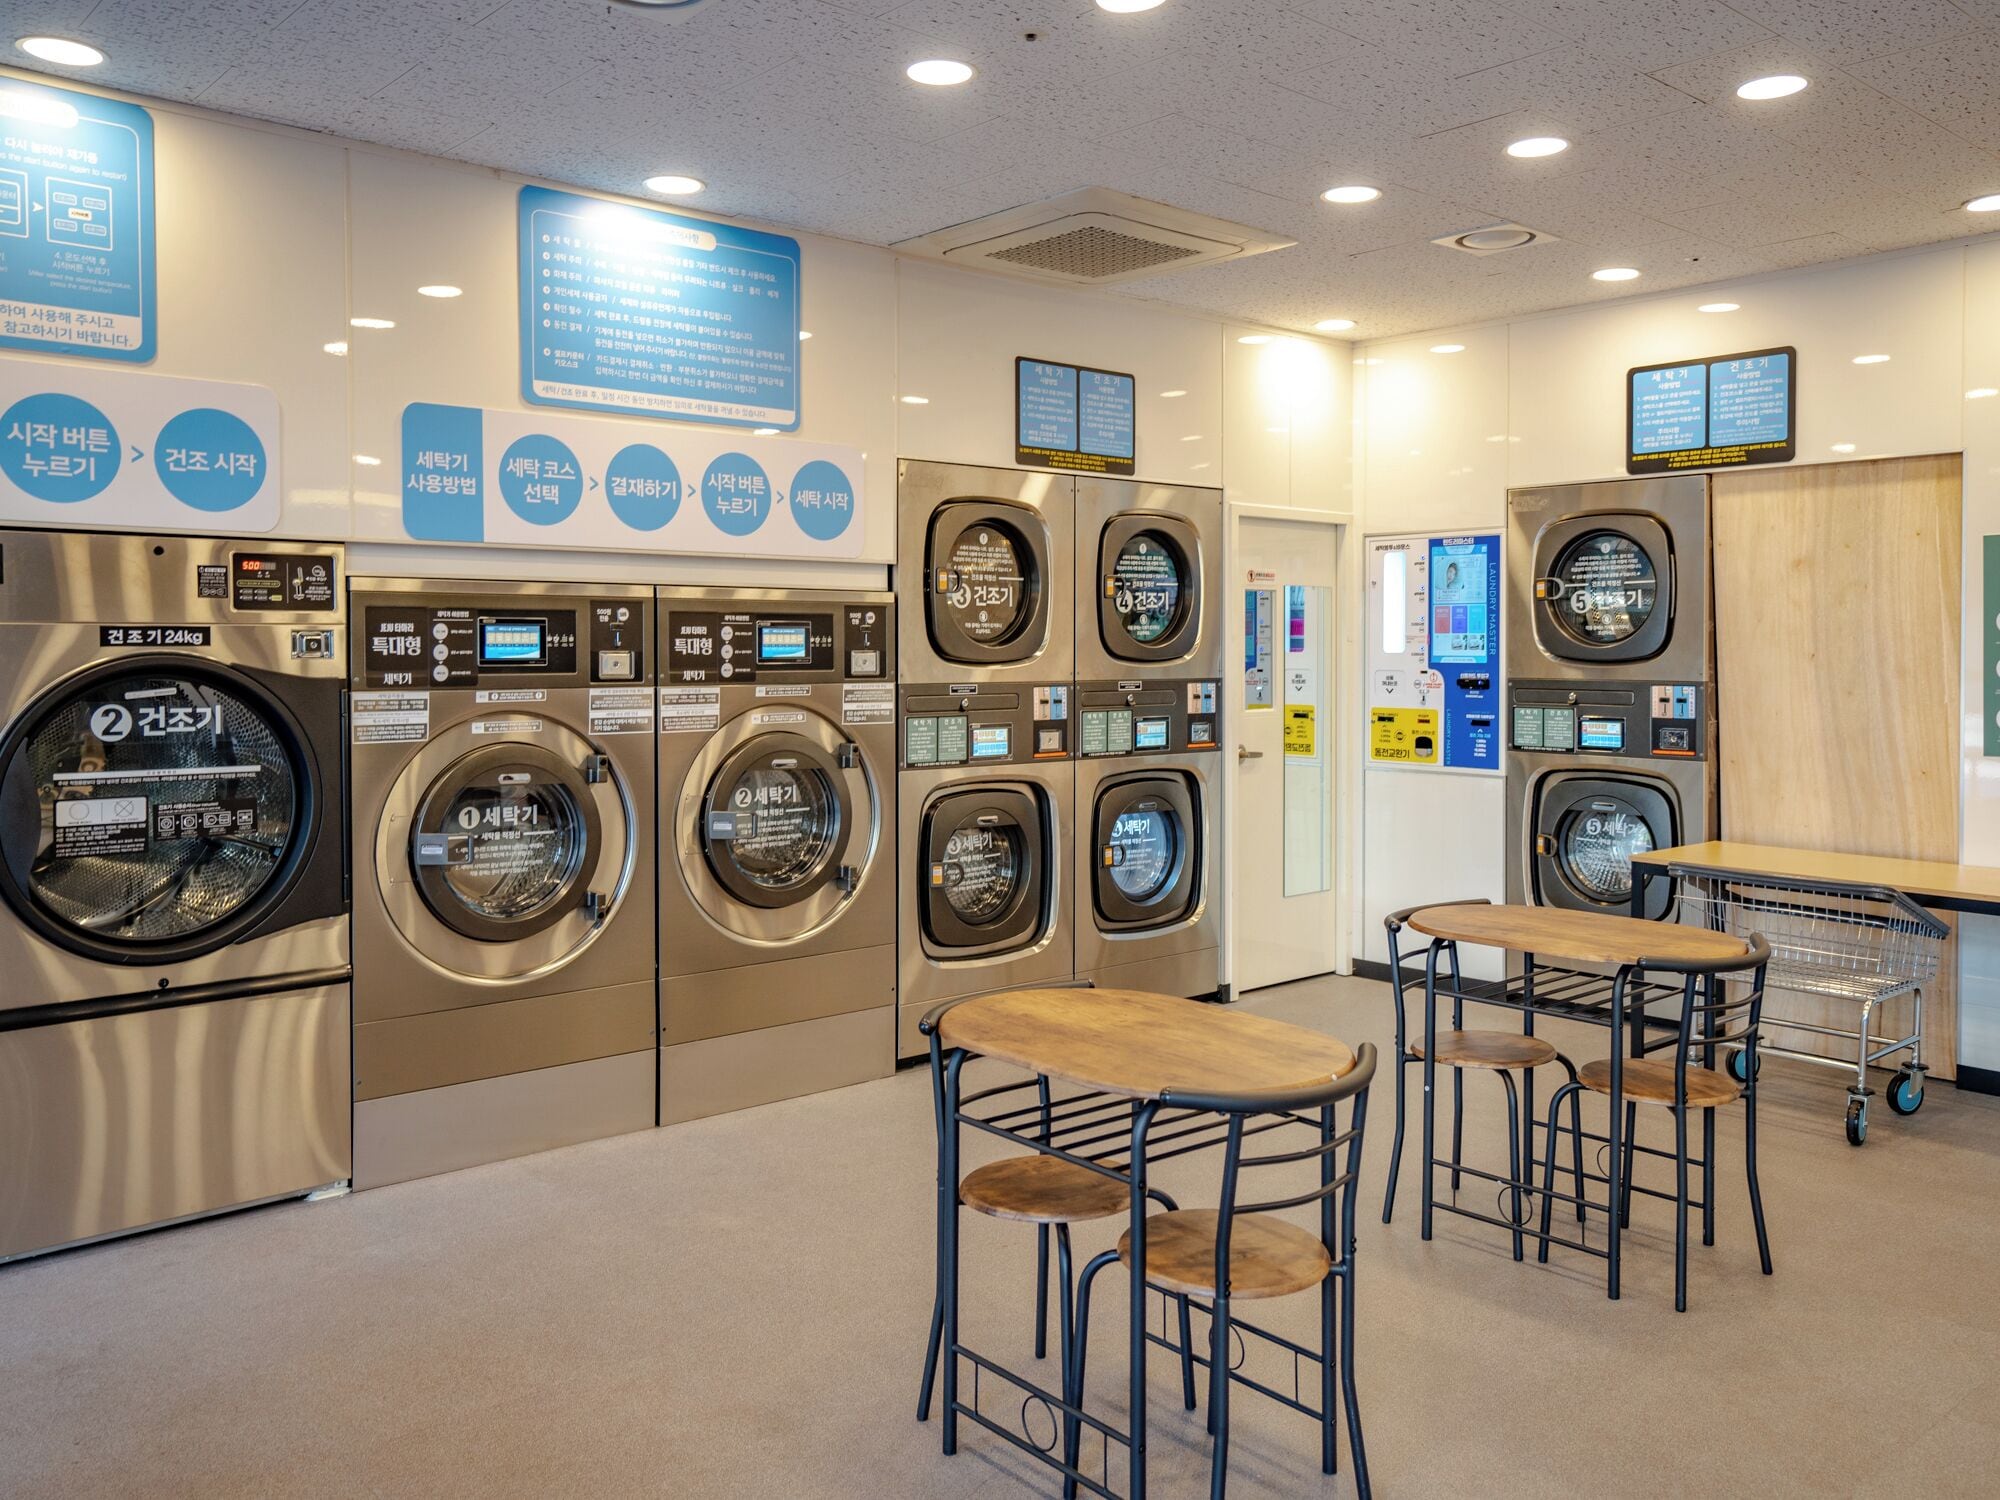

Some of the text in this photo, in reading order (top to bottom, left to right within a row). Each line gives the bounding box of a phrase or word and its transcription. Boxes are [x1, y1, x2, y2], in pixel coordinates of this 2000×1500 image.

[31, 307, 70, 324] 사용해
[75, 314, 114, 329] 주시고
[4, 319, 132, 348] 참고하시기 바랍니다.
[7, 421, 111, 453] 시작 버튼
[22, 453, 96, 481] 누르기
[165, 449, 258, 477] 건조 시작
[415, 450, 468, 472] 세탁기
[506, 457, 576, 480] 세탁 코스
[407, 474, 477, 496] 사용방법
[611, 476, 678, 500] 결재하기
[707, 471, 767, 494] 시작 버튼
[523, 484, 560, 505] 선택
[794, 489, 849, 511] 세탁 시작
[715, 496, 758, 517] 누르기
[243, 561, 261, 570] 500
[974, 585, 1013, 607] 건조기
[1134, 591, 1169, 611] 건조기
[1592, 589, 1642, 610] 건조기
[1488, 562, 1497, 655] LAUNDRY MASTER
[164, 629, 204, 646] 24kg
[371, 636, 422, 656] 특대형
[674, 638, 713, 656] 특대형
[383, 672, 413, 685] 세탁기
[682, 670, 706, 681] 세탁기
[137, 704, 222, 738] 건조기
[1374, 747, 1410, 759] 동전교환기
[754, 784, 797, 805] 세탁기
[482, 804, 538, 826] 세탁기
[481, 830, 521, 840] 세탁물 적정선
[1123, 818, 1150, 835] 세탁기
[961, 832, 993, 851] 세탁기
